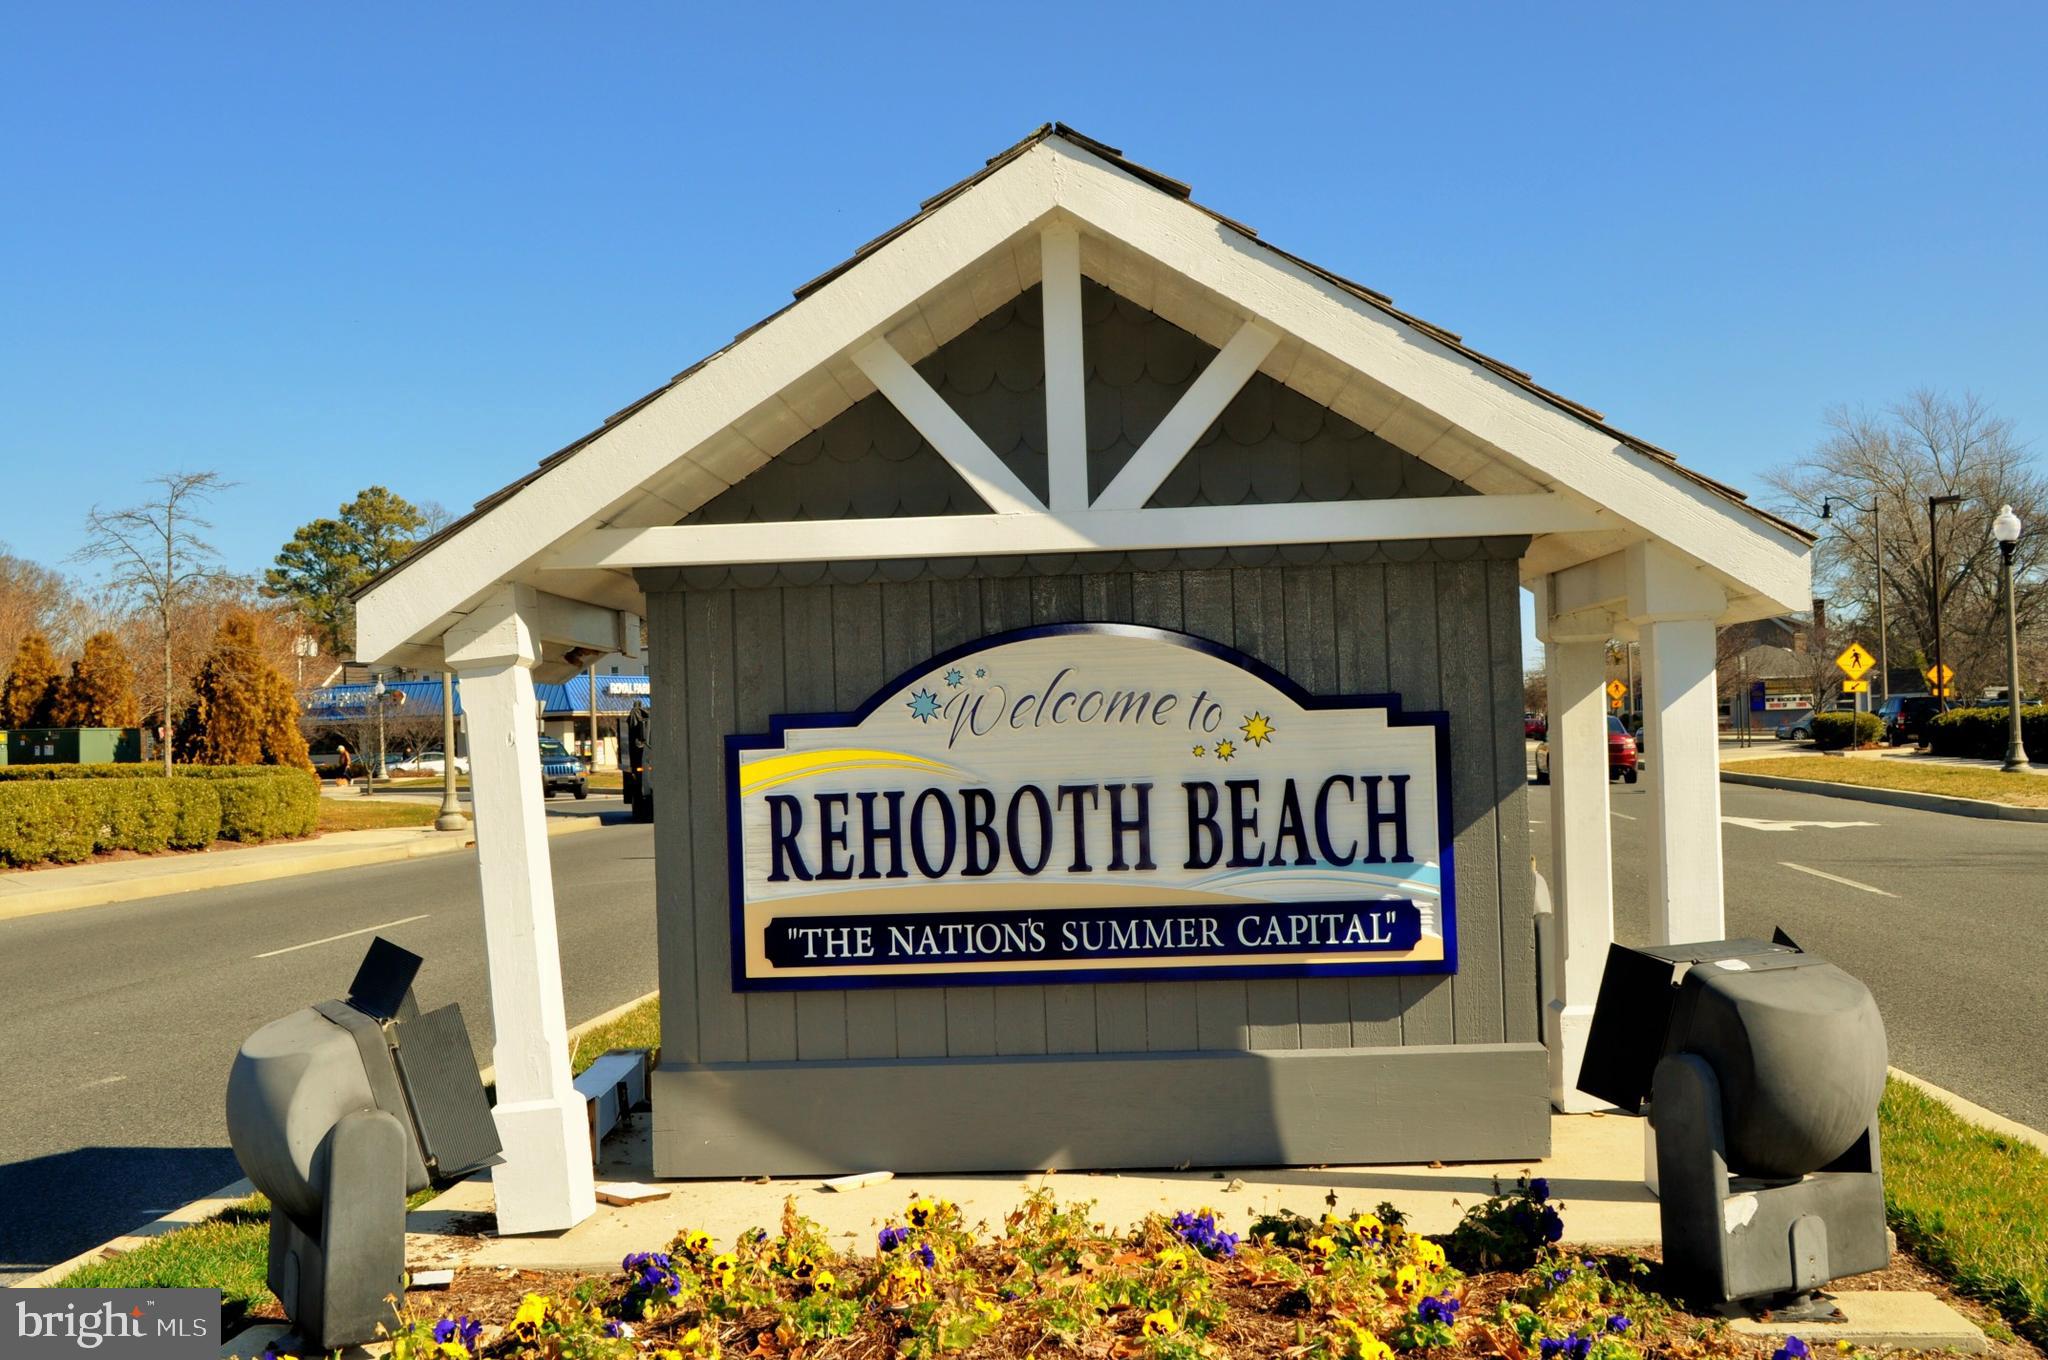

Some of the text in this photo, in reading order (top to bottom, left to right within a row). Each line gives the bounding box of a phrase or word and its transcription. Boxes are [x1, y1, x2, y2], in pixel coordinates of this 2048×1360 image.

[943, 667, 1224, 750] Welcome to
[765, 773, 1415, 882] REHOBOTH BEACH
[787, 925, 874, 959] "THE
[1061, 918, 1224, 951] SUMMER
[1237, 911, 1397, 947] CAPITAL"
